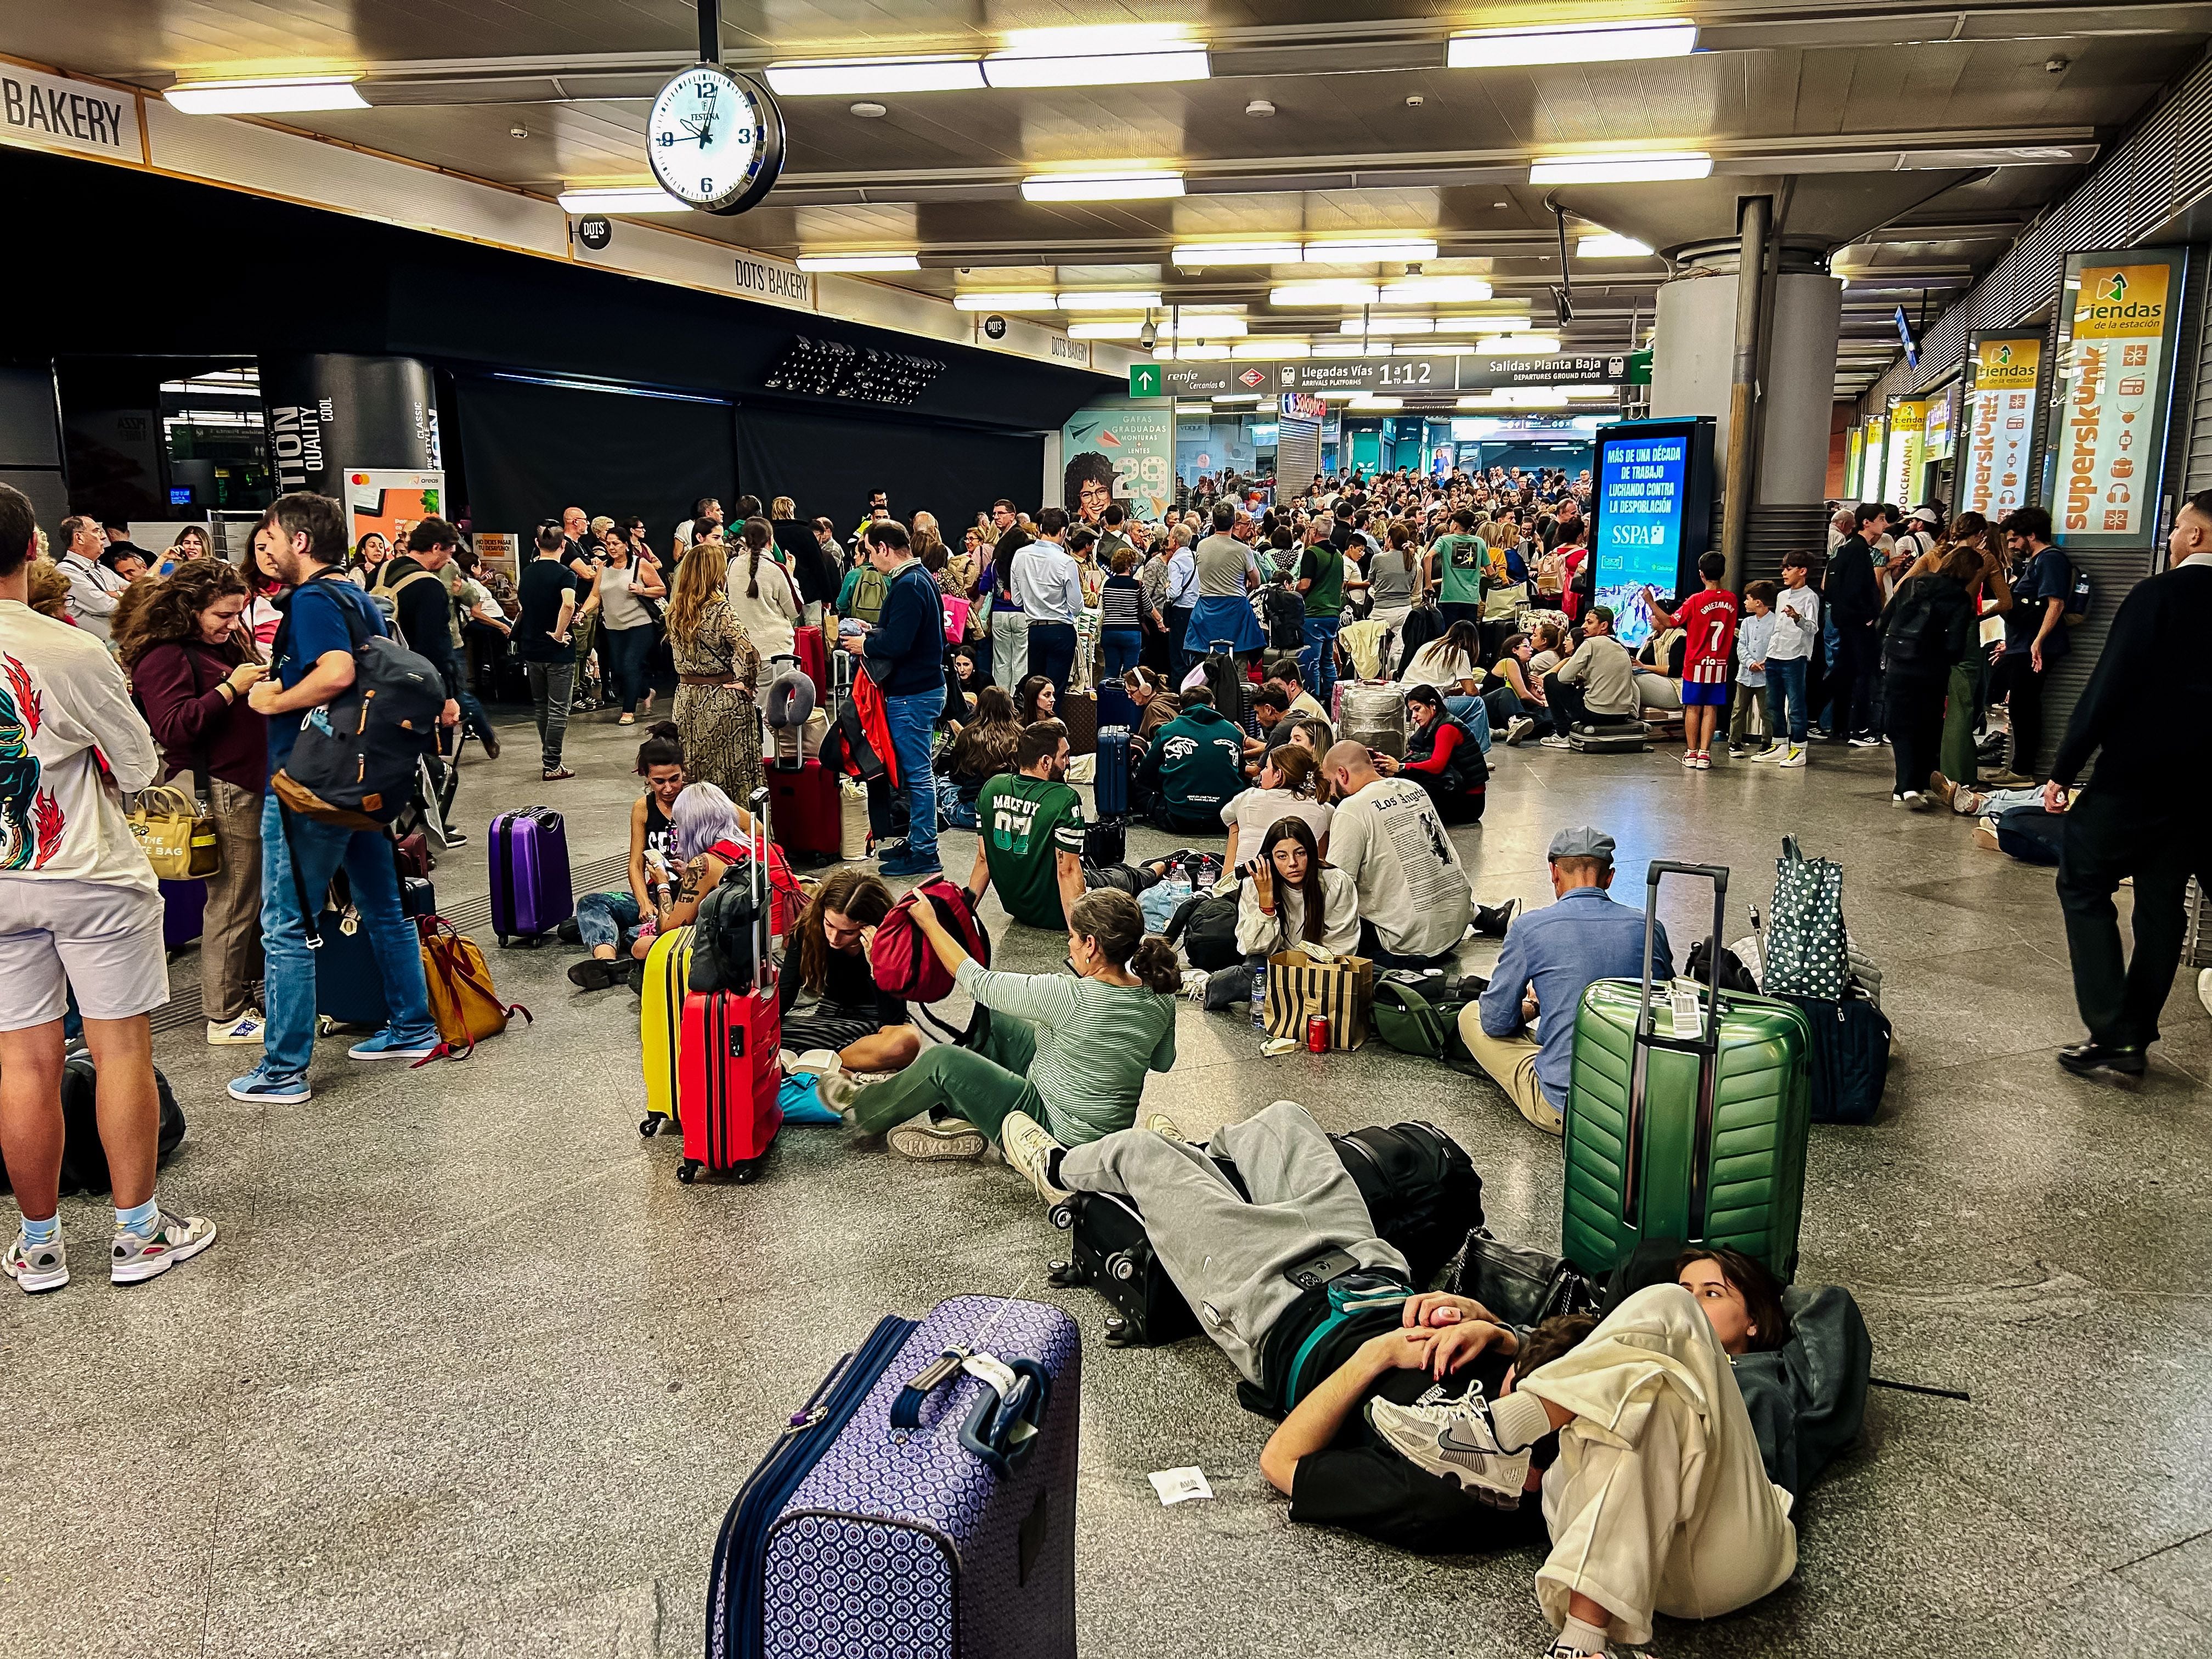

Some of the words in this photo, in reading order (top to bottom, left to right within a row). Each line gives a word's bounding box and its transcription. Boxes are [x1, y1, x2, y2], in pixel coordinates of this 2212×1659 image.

[695, 82, 718, 99] 12
[2, 77, 121, 146] BAKERY
[691, 113, 720, 121] FESTINA
[662, 132, 674, 147] 9
[738, 128, 751, 144] 3
[701, 177, 713, 193] 6
[583, 221, 605, 236] DOTS
[735, 259, 764, 291] DOTS
[768, 267, 808, 301] BAKERY
[2089, 302, 2162, 320] iendas
[988, 321, 1002, 331] DOTS
[2094, 320, 2103, 329] de
[2105, 320, 2117, 329] la
[2119, 319, 2160, 329] estación
[1052, 336, 1066, 358] DOTS
[1068, 340, 1087, 362] BAKERY
[1302, 366, 1348, 379] Llegadas
[1351, 364, 1373, 377] Vías
[1489, 360, 1530, 373] Salidas
[1534, 359, 1572, 371] Planta
[1576, 358, 1601, 371] Baja
[1978, 364, 2035, 378] tiendas
[1167, 369, 1198, 383] renfe
[1379, 364, 1392, 385] 1
[1393, 366, 1401, 376] a
[1402, 363, 1431, 385] 12
[1189, 381, 1218, 390] Cercanías
[319, 397, 334, 422] COOL
[1296, 393, 1326, 416] Soloptical
[415, 402, 425, 439] CLASSIC
[1111, 425, 1166, 433] GRADUADAS
[299, 407, 324, 471] QUALITY
[273, 407, 312, 500] TION
[1607, 447, 1624, 464] MÁS
[1626, 449, 1635, 463] DE
[1636, 448, 1650, 462] UNA
[1652, 444, 1681, 461] DÉCADA
[1972, 393, 1999, 518] uperskunk
[1112, 456, 1168, 499] 29
[1621, 466, 1630, 479] DE
[1632, 465, 1664, 479] TRABAJO
[1609, 483, 1645, 497] LUCHANDO
[1646, 482, 1674, 496] CONTRA
[1609, 500, 1619, 514] LA
[1620, 497, 1672, 514] DESPOBLACIÓN
[1612, 525, 1650, 545] SSPA
[1710, 621, 1724, 652] 7
[1701, 656, 1716, 665] ria
[993, 794, 1041, 816] MALFOY
[1372, 795, 1397, 811] Los
[994, 809, 1033, 854] 07
[143, 836, 163, 845] THE
[156, 847, 183, 856] BAG
